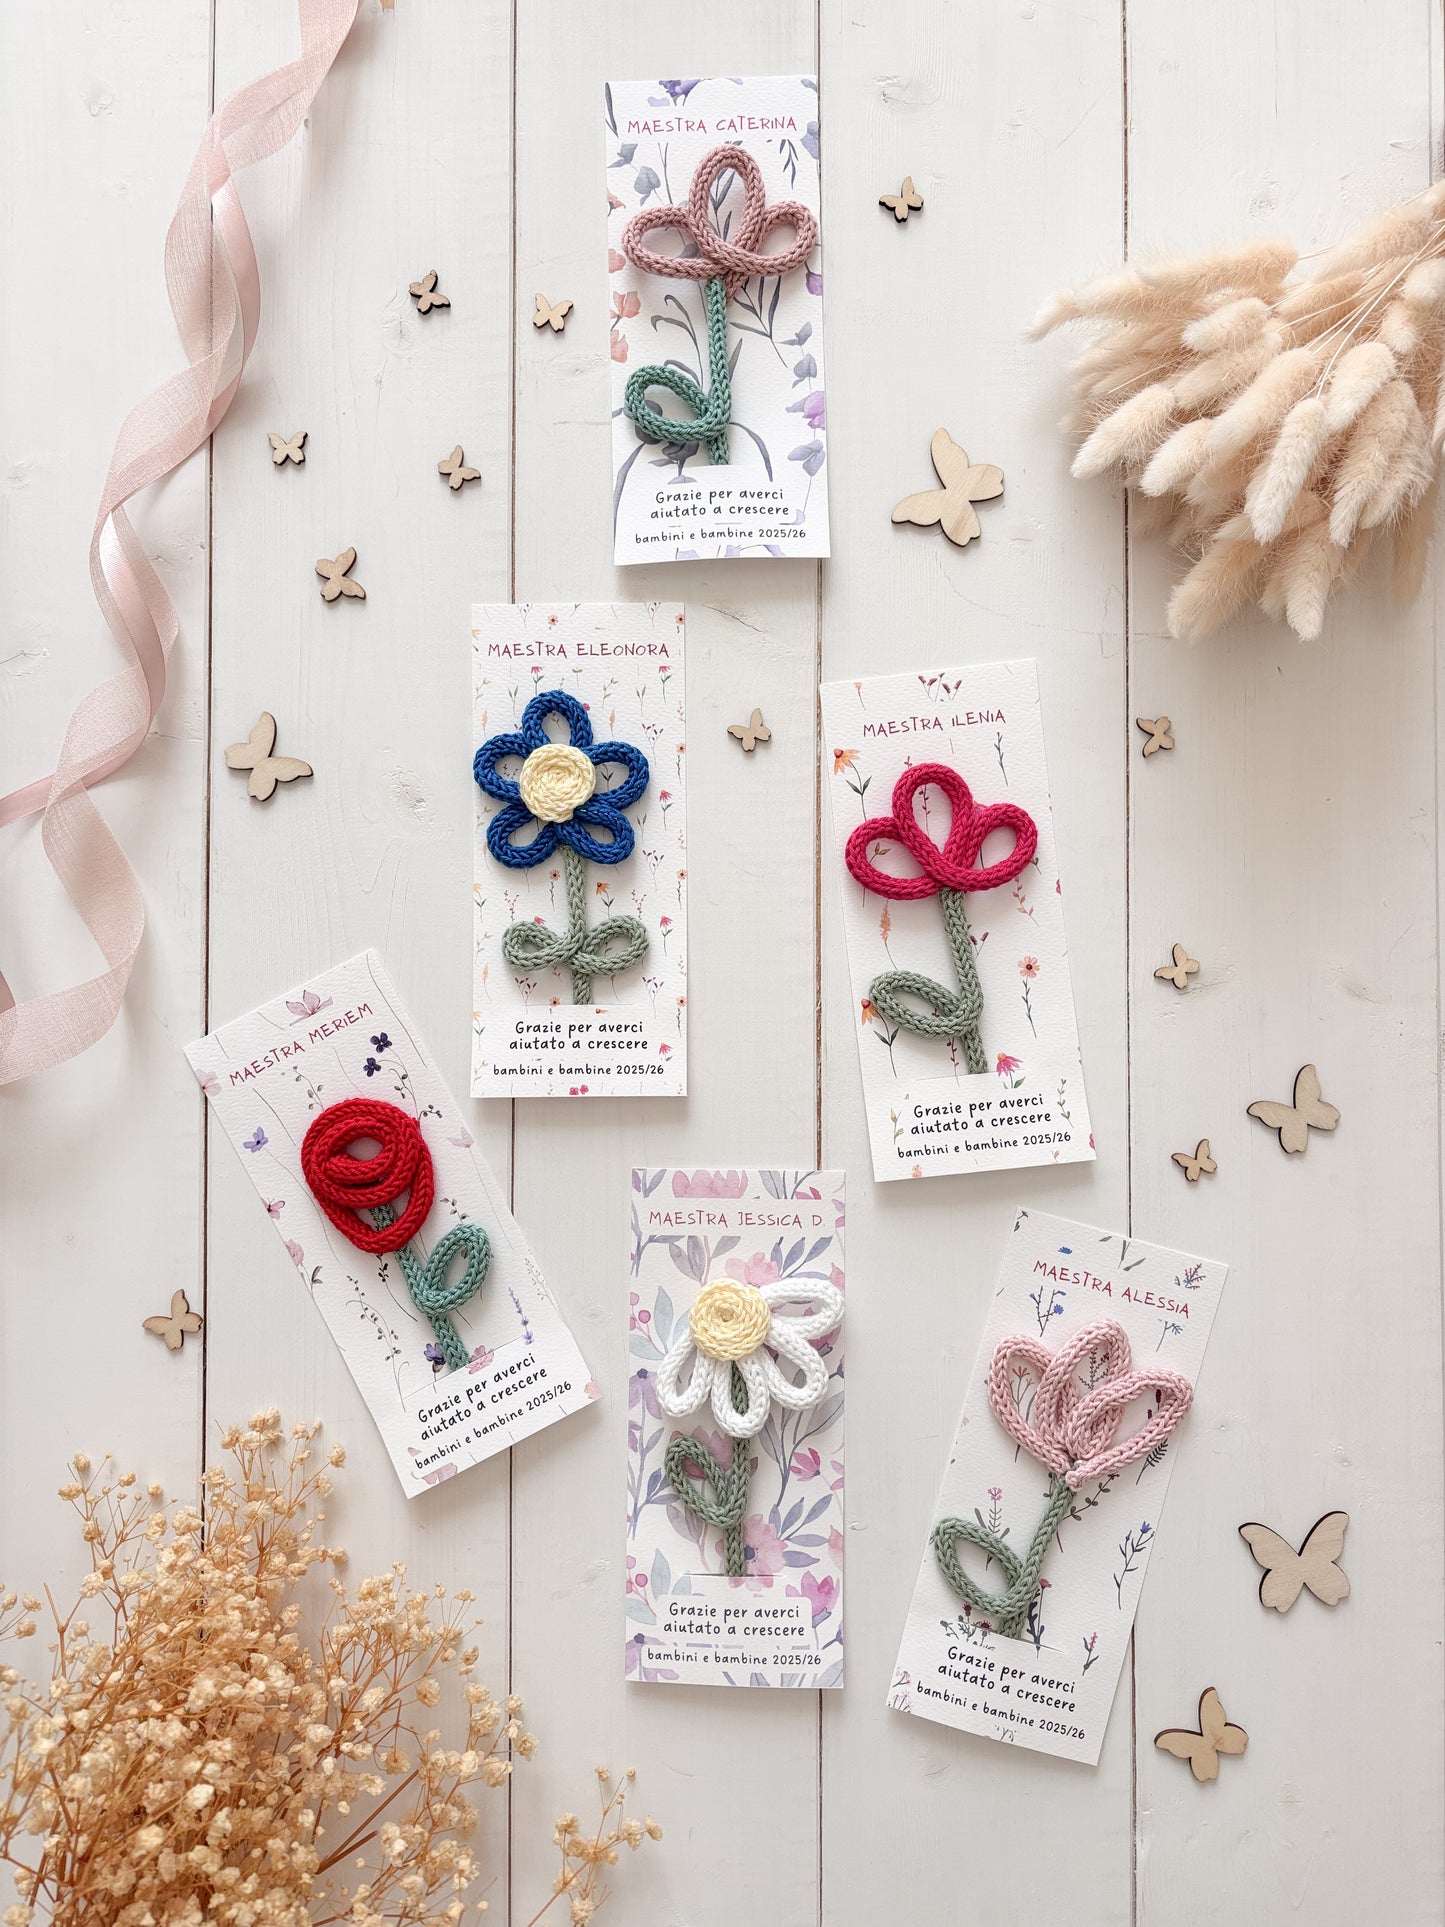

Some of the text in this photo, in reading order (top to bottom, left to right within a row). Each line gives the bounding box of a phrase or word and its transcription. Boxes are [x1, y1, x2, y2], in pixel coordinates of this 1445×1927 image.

[628, 116, 797, 135] MAESTRA CATERINA
[655, 489, 783, 504] Grazie per averci
[650, 504, 789, 519] aiutato a crescere
[635, 532, 684, 544] bambini
[700, 528, 753, 538] bambine
[759, 529, 806, 538] 2025/26
[488, 641, 669, 659] MAESTRA ELEONORA
[863, 709, 1006, 738] MAESTRA ILENIA
[515, 1021, 643, 1038] Grazie per averci
[229, 1003, 373, 1086] MAESTRA MERIEM
[510, 1037, 648, 1049] aiutato a crescere
[494, 1064, 664, 1075] bambini e bambine 2025/26
[914, 1094, 1043, 1118] Grazie per averci
[911, 1113, 1051, 1135] aiutato a crescere
[898, 1132, 1071, 1158] bambini e bambine 2025/26
[649, 1210, 728, 1228] MAESTRA
[738, 1211, 802, 1229] JESSICA
[1033, 1260, 1189, 1319] MAESTRA ALESSIA
[418, 1353, 536, 1423] Grazie per averci
[421, 1369, 548, 1440] aiutato a crescere
[415, 1439, 461, 1469] bambini
[473, 1408, 523, 1438] bambine
[527, 1381, 571, 1411] 2025/26
[669, 1602, 799, 1623] Grazie per averci
[664, 1621, 805, 1636] aiutato a crescere
[647, 1650, 697, 1662] bambini
[714, 1651, 767, 1665] bambine
[773, 1654, 821, 1665] 2025/26
[948, 1646, 1075, 1694] Grazie per averci
[938, 1664, 1075, 1712] aiutato a crescere
[917, 1681, 1085, 1740] bambini e bambine 2025/26
